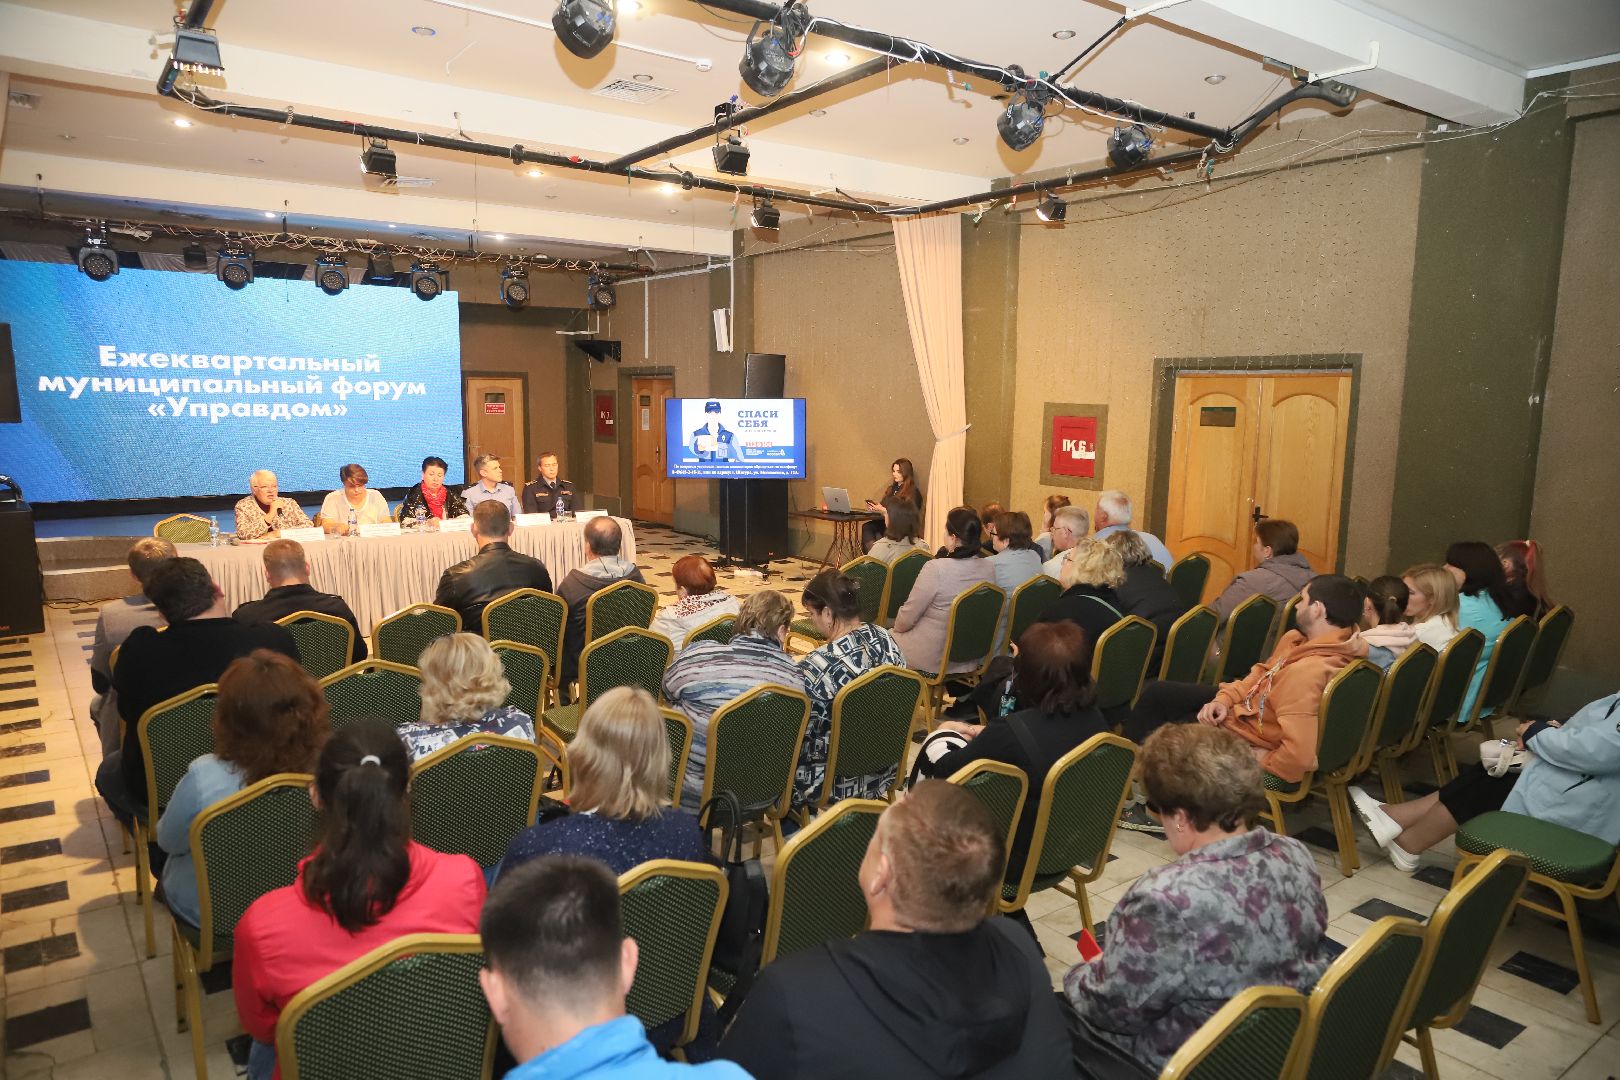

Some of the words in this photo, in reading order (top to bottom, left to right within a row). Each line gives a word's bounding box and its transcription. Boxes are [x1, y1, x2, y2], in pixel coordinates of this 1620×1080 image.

[99, 345, 381, 375] Ежеквартальный
[38, 374, 323, 399] муниципальный
[331, 376, 426, 400] форум
[147, 396, 348, 424] «Управдом»
[737, 410, 778, 418] СПАСИ
[737, 419, 769, 428] СЕБЯ
